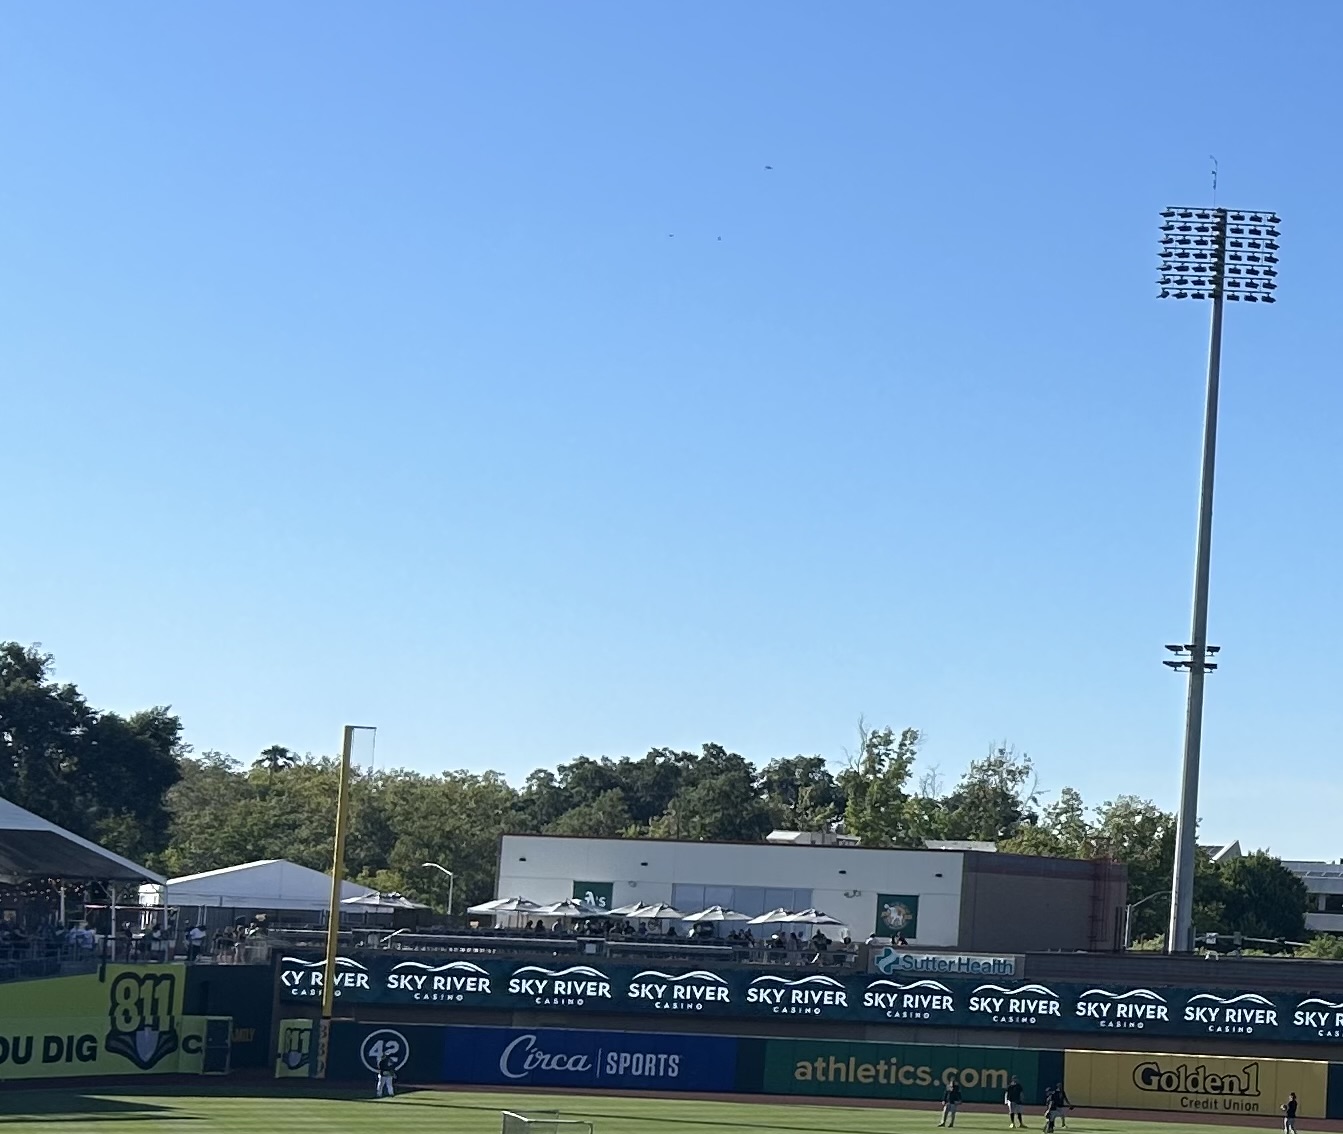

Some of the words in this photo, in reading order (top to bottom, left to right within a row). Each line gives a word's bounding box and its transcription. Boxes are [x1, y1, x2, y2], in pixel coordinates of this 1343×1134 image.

[901, 954, 957, 973] Sutter
[958, 956, 1013, 975] Health
[311, 971, 370, 989] RVER
[387, 974, 428, 991] SKY
[433, 976, 492, 994] RIVER
[508, 978, 549, 995] SKY
[554, 980, 612, 998] RIVER
[111, 972, 175, 1033] 811
[414, 992, 464, 1001] CASINO
[535, 997, 584, 1006] CASINO
[628, 983, 668, 1000] SKY
[673, 985, 730, 1002] RIVER
[747, 988, 785, 1006] SKY
[791, 990, 848, 1008] RIVER
[863, 992, 898, 1009] SKY
[903, 994, 955, 1012] RIVER
[655, 1001, 703, 1010] CASINO
[773, 1006, 821, 1015] CASINO
[887, 1010, 930, 1019] CASINO
[969, 996, 1004, 1013] SKY
[1009, 999, 1061, 1017] RIVER
[1075, 1001, 1111, 1018] SKY
[1116, 1004, 1169, 1022] RIVER
[992, 1015, 1036, 1024] CASINO
[1100, 1020, 1144, 1029] CASINO
[1184, 1006, 1220, 1023] SKY
[1225, 1008, 1278, 1026] RIVER
[1293, 1011, 1330, 1028] SKY
[1208, 1025, 1253, 1034] CASINO
[42, 1034, 98, 1063] DIG
[368, 1040, 399, 1063] 42
[500, 1034, 592, 1078] Circa
[606, 1051, 680, 1077] SPORTS
[794, 1056, 1008, 1089] athletics.com
[1180, 1096, 1218, 1110] Credit
[1223, 1098, 1259, 1112] Union
